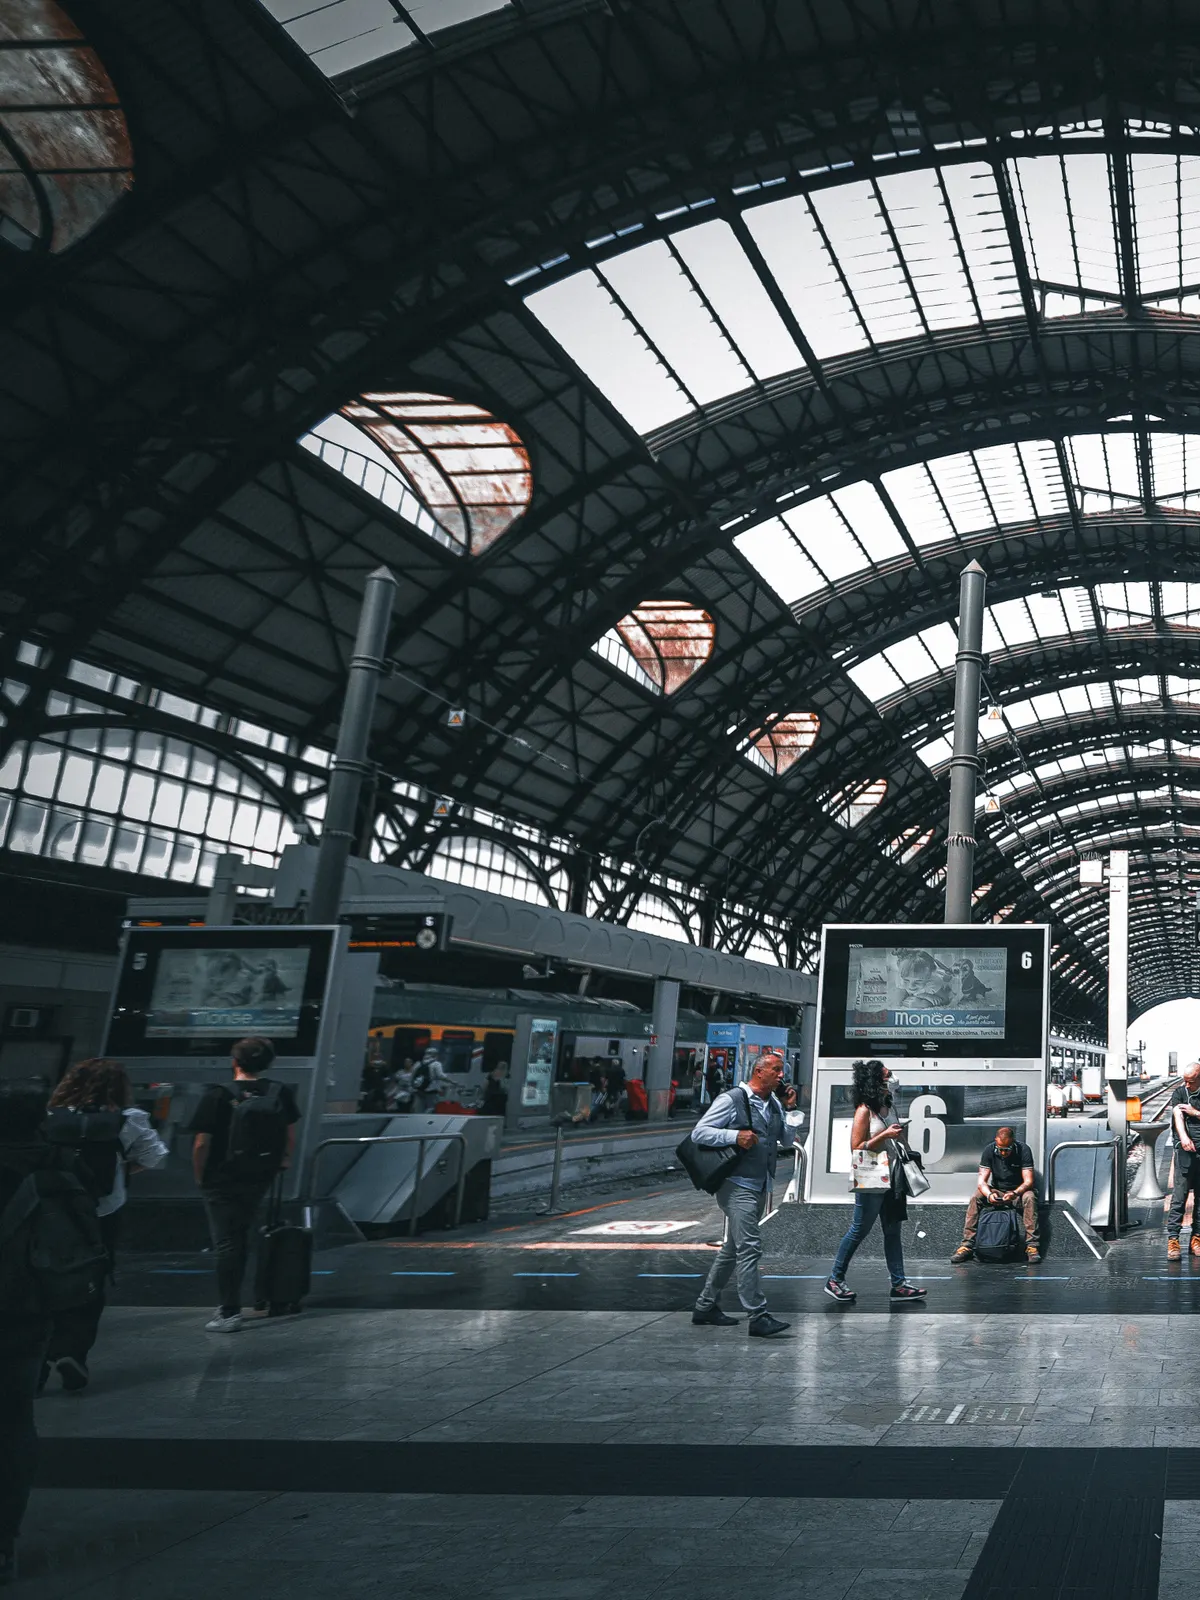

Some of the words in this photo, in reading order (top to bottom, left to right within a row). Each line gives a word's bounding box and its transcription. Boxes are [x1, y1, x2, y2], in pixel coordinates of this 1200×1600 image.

[132, 952, 148, 971] 5
[1021, 951, 1033, 970] 6
[908, 1094, 947, 1164] 6
